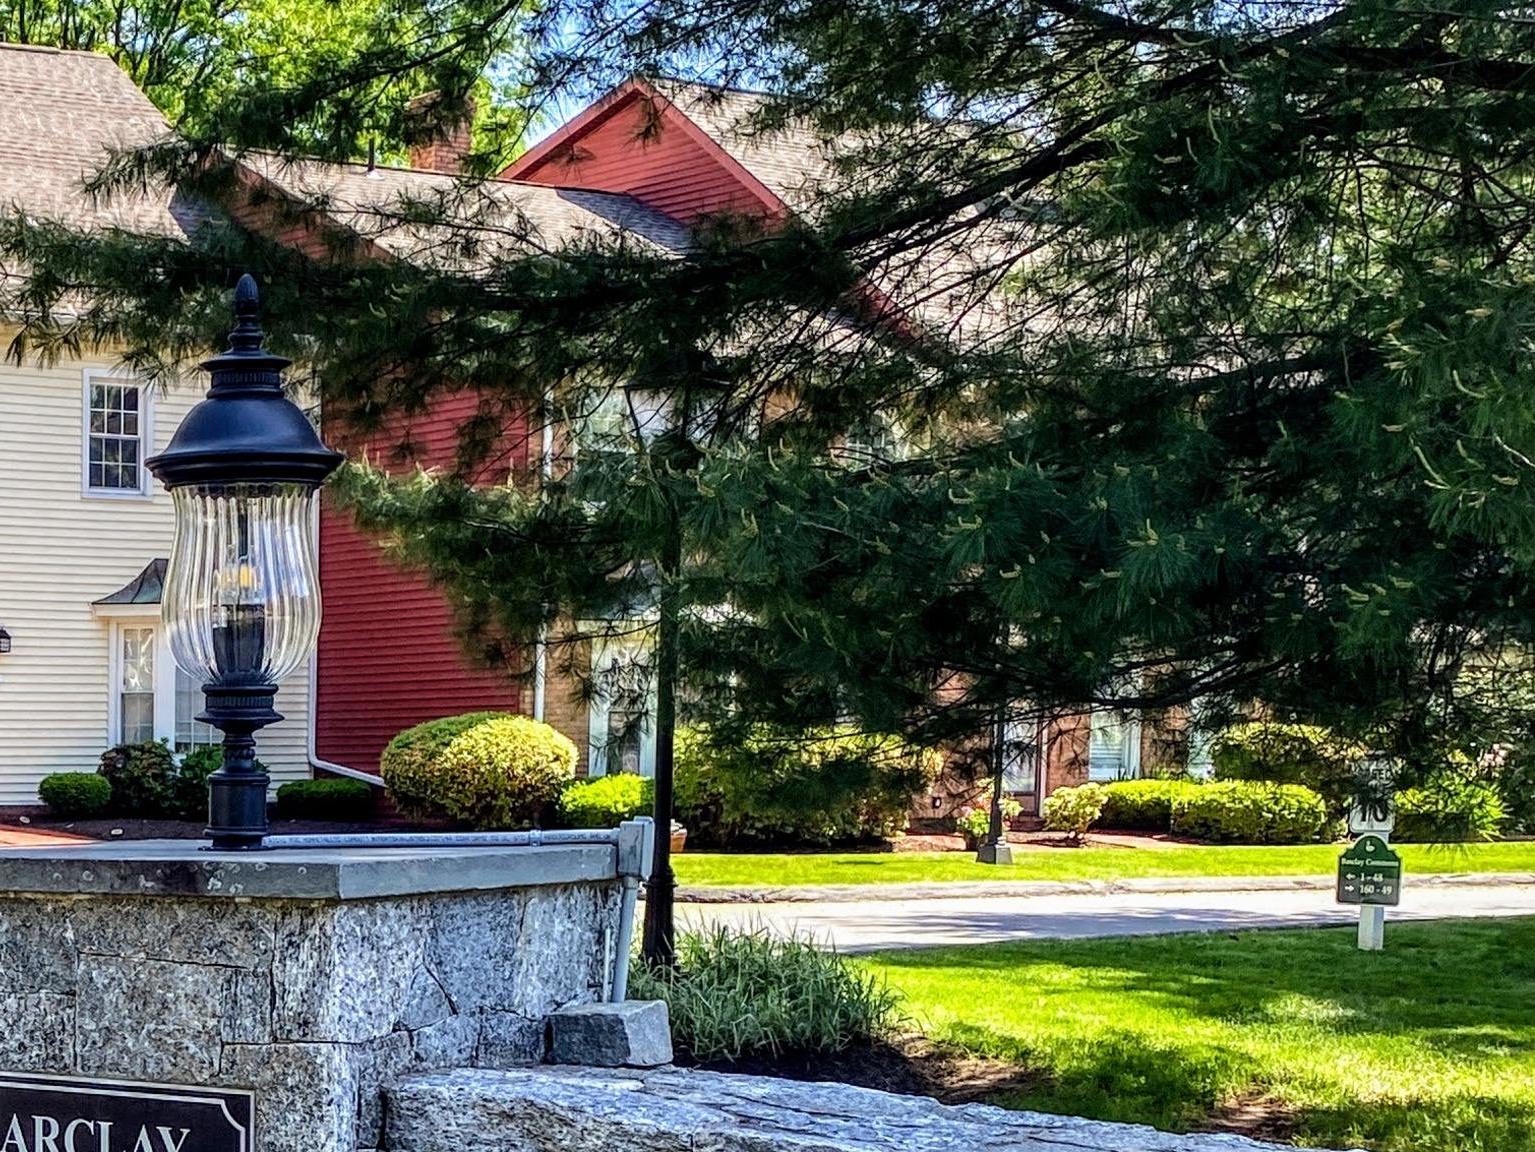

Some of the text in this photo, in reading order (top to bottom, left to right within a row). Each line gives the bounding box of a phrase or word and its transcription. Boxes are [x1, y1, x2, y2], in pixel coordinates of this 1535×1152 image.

[1341, 857, 1365, 868] Barclay
[1359, 885, 1375, 894] 160
[1381, 886, 1393, 895] 49
